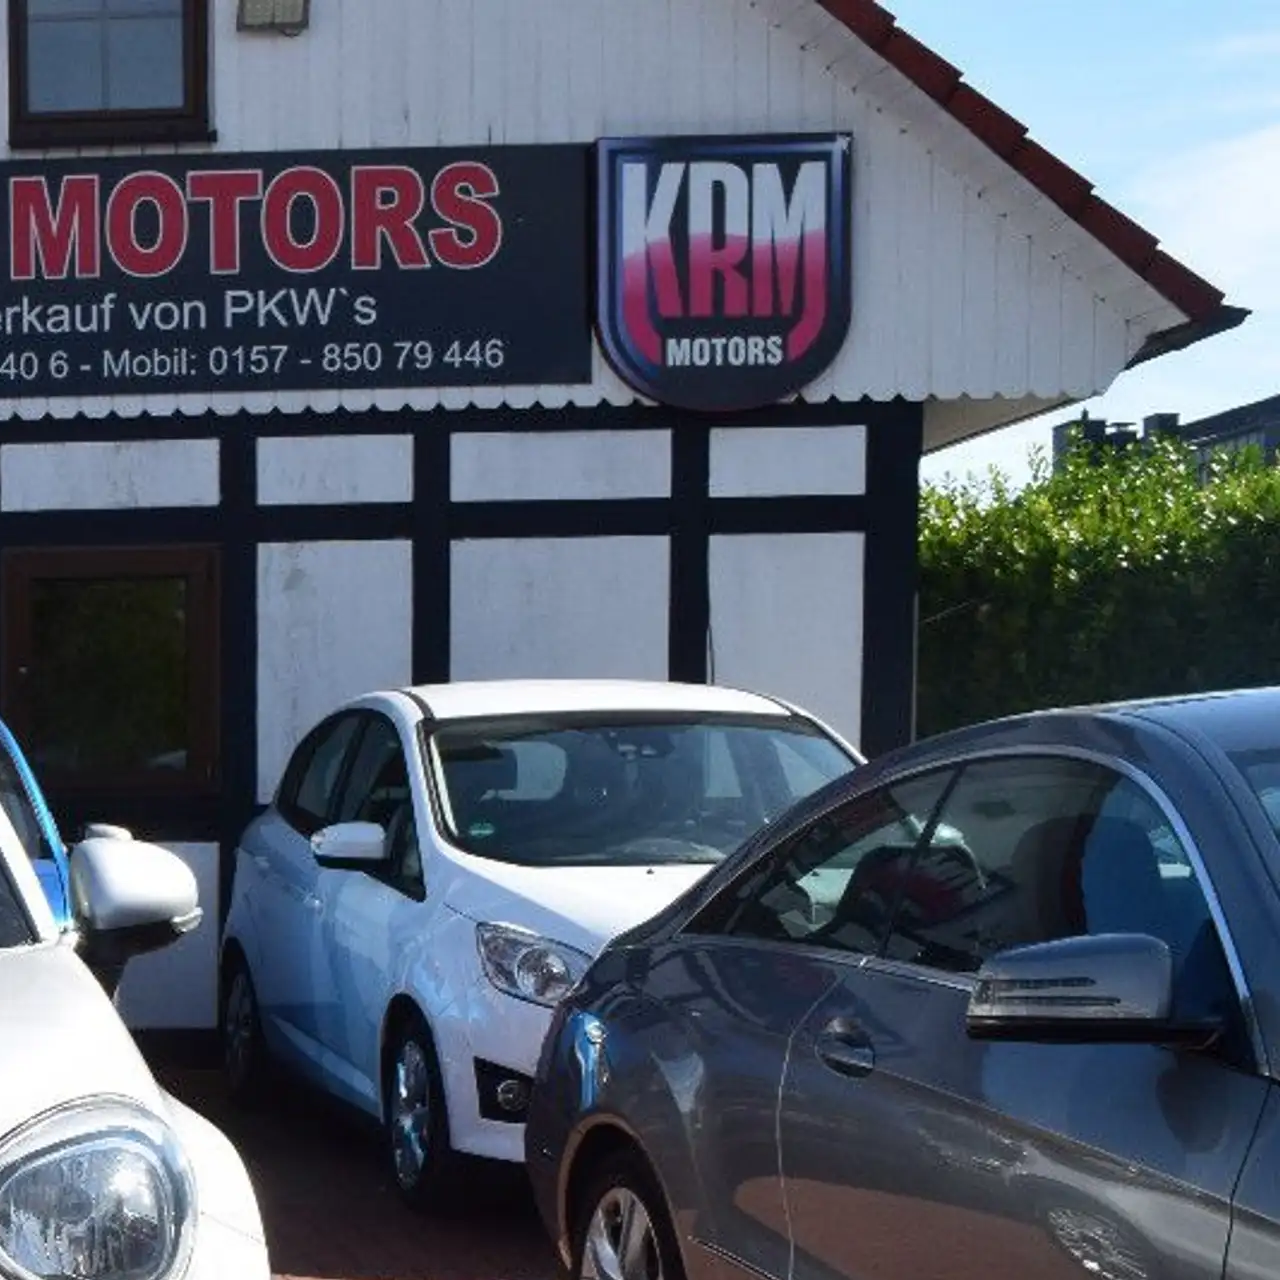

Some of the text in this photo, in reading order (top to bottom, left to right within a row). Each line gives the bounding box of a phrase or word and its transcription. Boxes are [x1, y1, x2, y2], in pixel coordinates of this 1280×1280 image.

[9, 160, 503, 282] MOTORS
[621, 161, 827, 365] KRM
[128, 300, 207, 332] von
[48, 350, 70, 379] 6
[102, 347, 197, 378] Mobil:
[208, 344, 289, 374] 0157
[321, 342, 382, 372] 850
[393, 340, 433, 370] 79
[442, 339, 505, 369] 446
[665, 335, 783, 367] MOTORS
